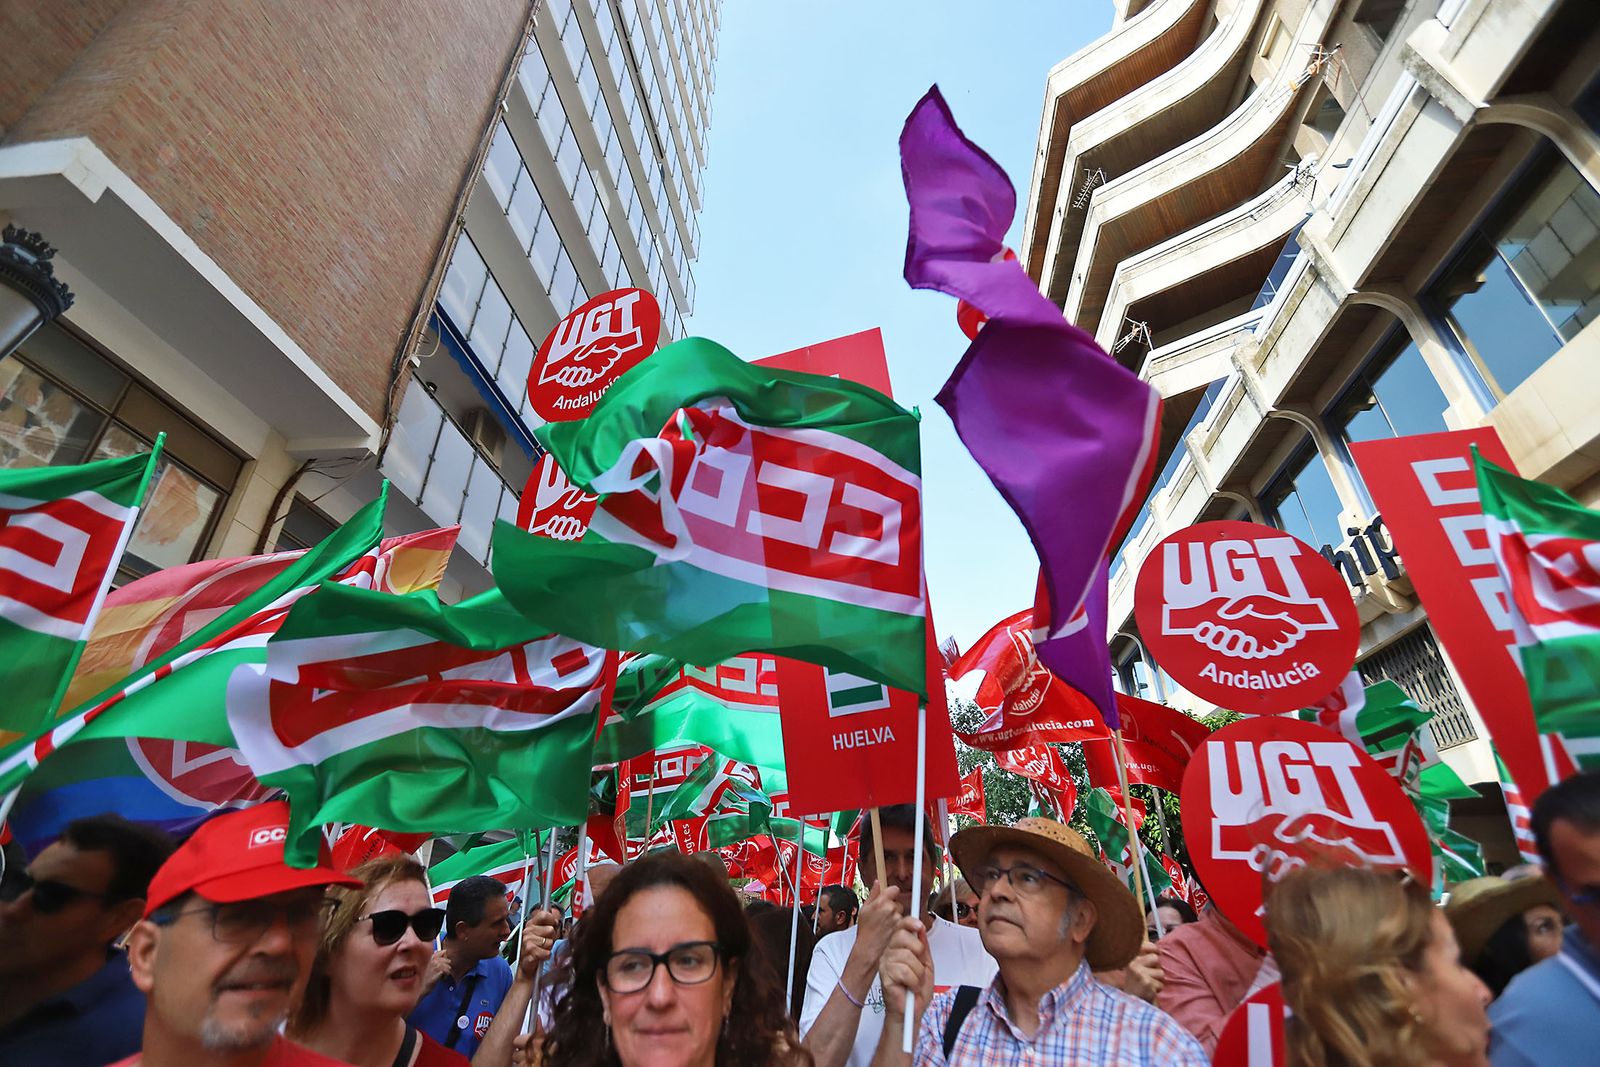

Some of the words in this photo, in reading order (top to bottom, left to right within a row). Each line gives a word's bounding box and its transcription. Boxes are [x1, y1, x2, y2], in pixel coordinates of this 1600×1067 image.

[547, 290, 640, 363] UGT
[1163, 537, 1302, 609] UGT
[1198, 662, 1320, 690] Andalucía
[832, 725, 896, 751] HUELVA
[1207, 741, 1362, 826] UGT
